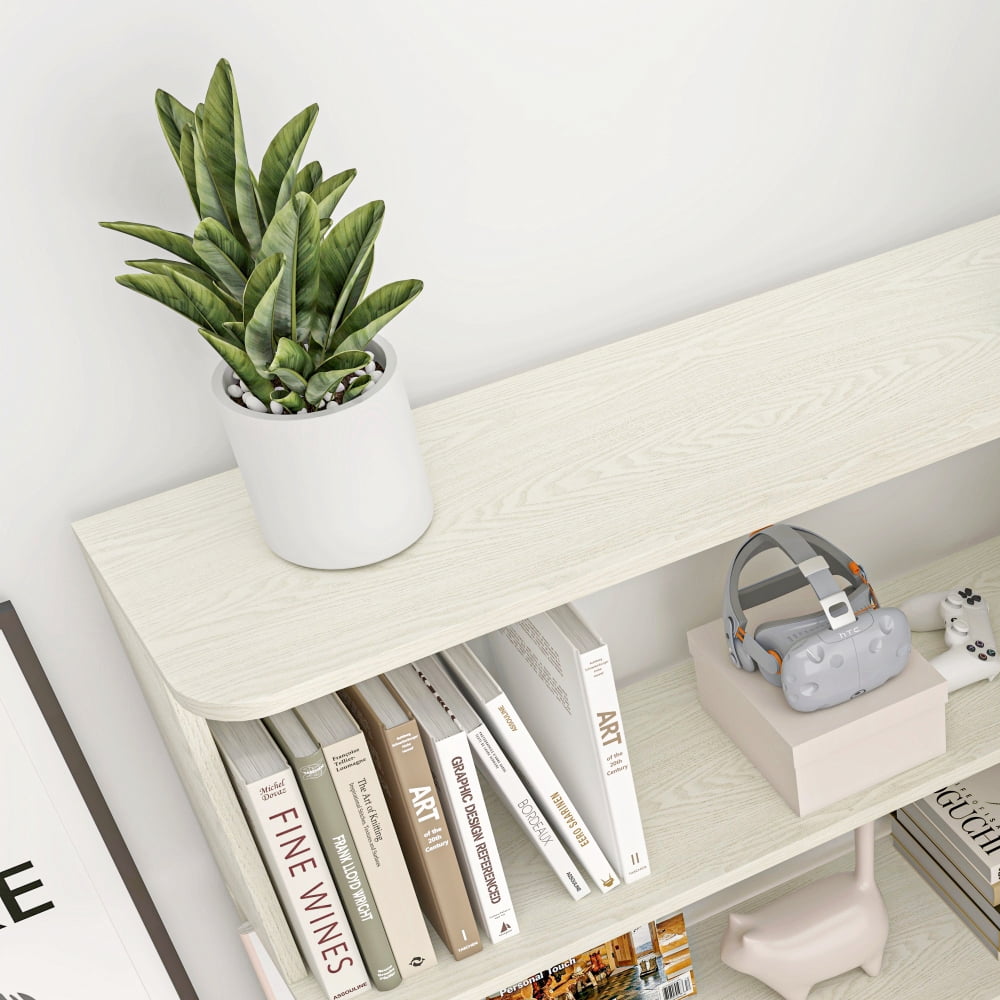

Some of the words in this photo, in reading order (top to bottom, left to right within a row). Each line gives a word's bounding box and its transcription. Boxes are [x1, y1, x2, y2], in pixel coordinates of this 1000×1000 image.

[596, 710, 622, 746] ART
[613, 751, 623, 759] the
[606, 765, 628, 776] Century
[259, 778, 286, 796] Michel
[262, 788, 287, 801] Dovaz
[358, 777, 368, 793] The
[362, 794, 372, 807] Art
[408, 786, 440, 823] ART
[550, 791, 577, 829] SAARINEN
[369, 814, 383, 843] Knitting
[432, 827, 442, 835] the
[451, 756, 473, 804] GRAPHIC
[464, 803, 484, 843] DESIGN
[475, 841, 501, 905] REFERENCED
[517, 798, 554, 847] BORDEAUX
[425, 840, 449, 854] Century
[428, 834, 442, 846] 20th
[574, 827, 590, 848] EERO
[332, 834, 352, 863] FRANK
[342, 862, 361, 891] LLOYD
[352, 887, 374, 922] WRIGHT
[0, 860, 55, 929] E
[269, 807, 318, 878] FINE
[300, 882, 353, 974] WINES
[500, 972, 543, 997] Personal
[548, 958, 576, 975] Touch
[333, 981, 368, 1000] ASSOULINE
